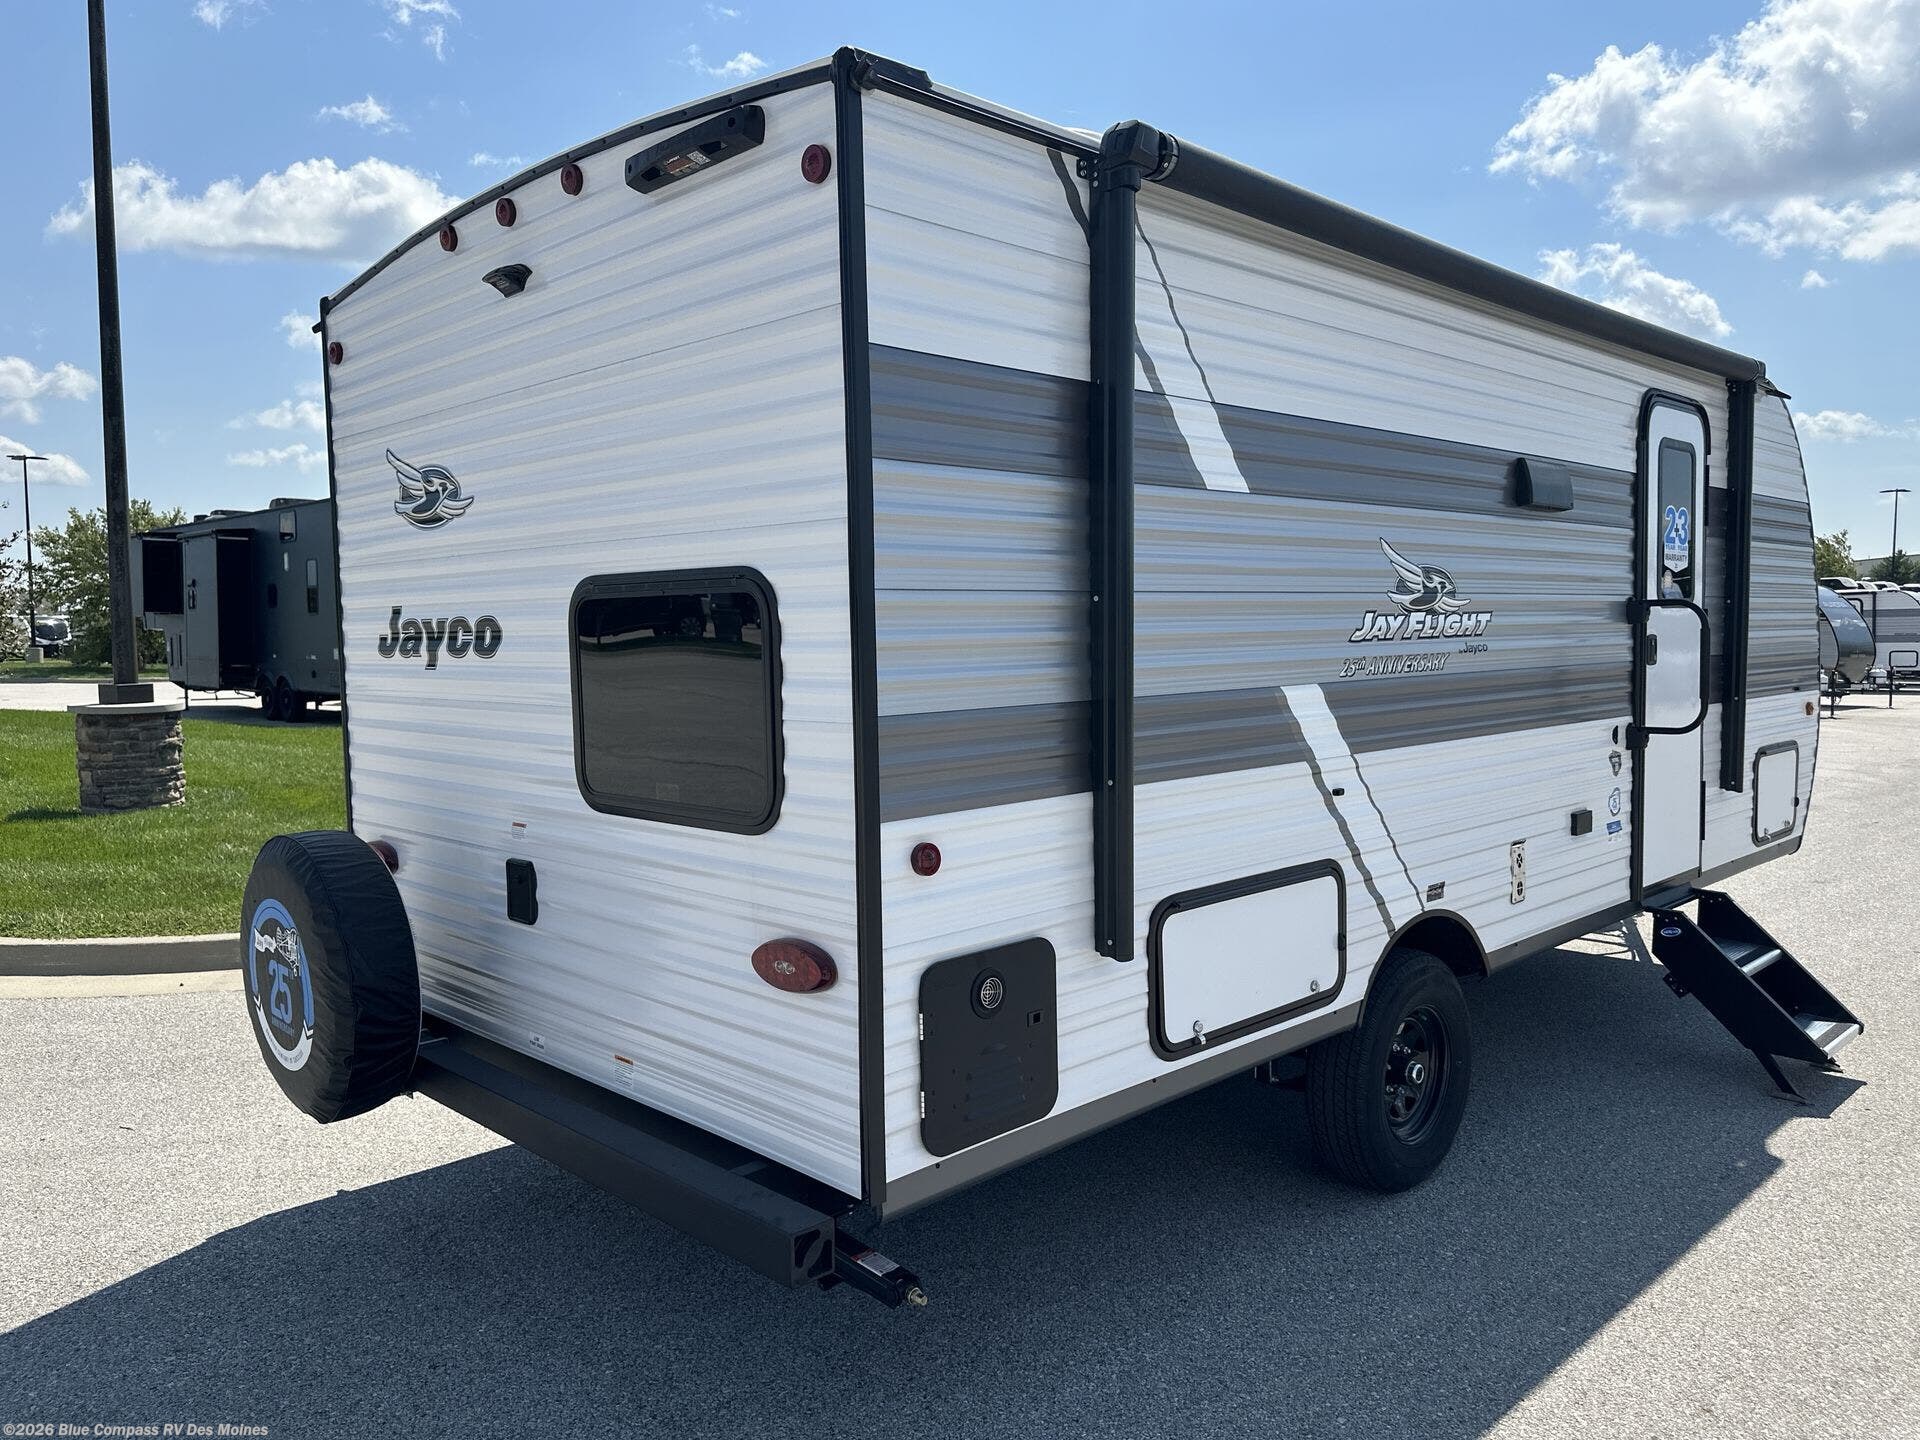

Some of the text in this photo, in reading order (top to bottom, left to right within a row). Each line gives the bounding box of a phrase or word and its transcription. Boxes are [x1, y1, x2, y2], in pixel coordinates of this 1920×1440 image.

[378, 605, 503, 671] Jayco
[1347, 610, 1493, 642] JAY FLIGHT
[1462, 642, 1488, 655] Jayco
[1338, 652, 1450, 678] 25th ANNIVERSARY
